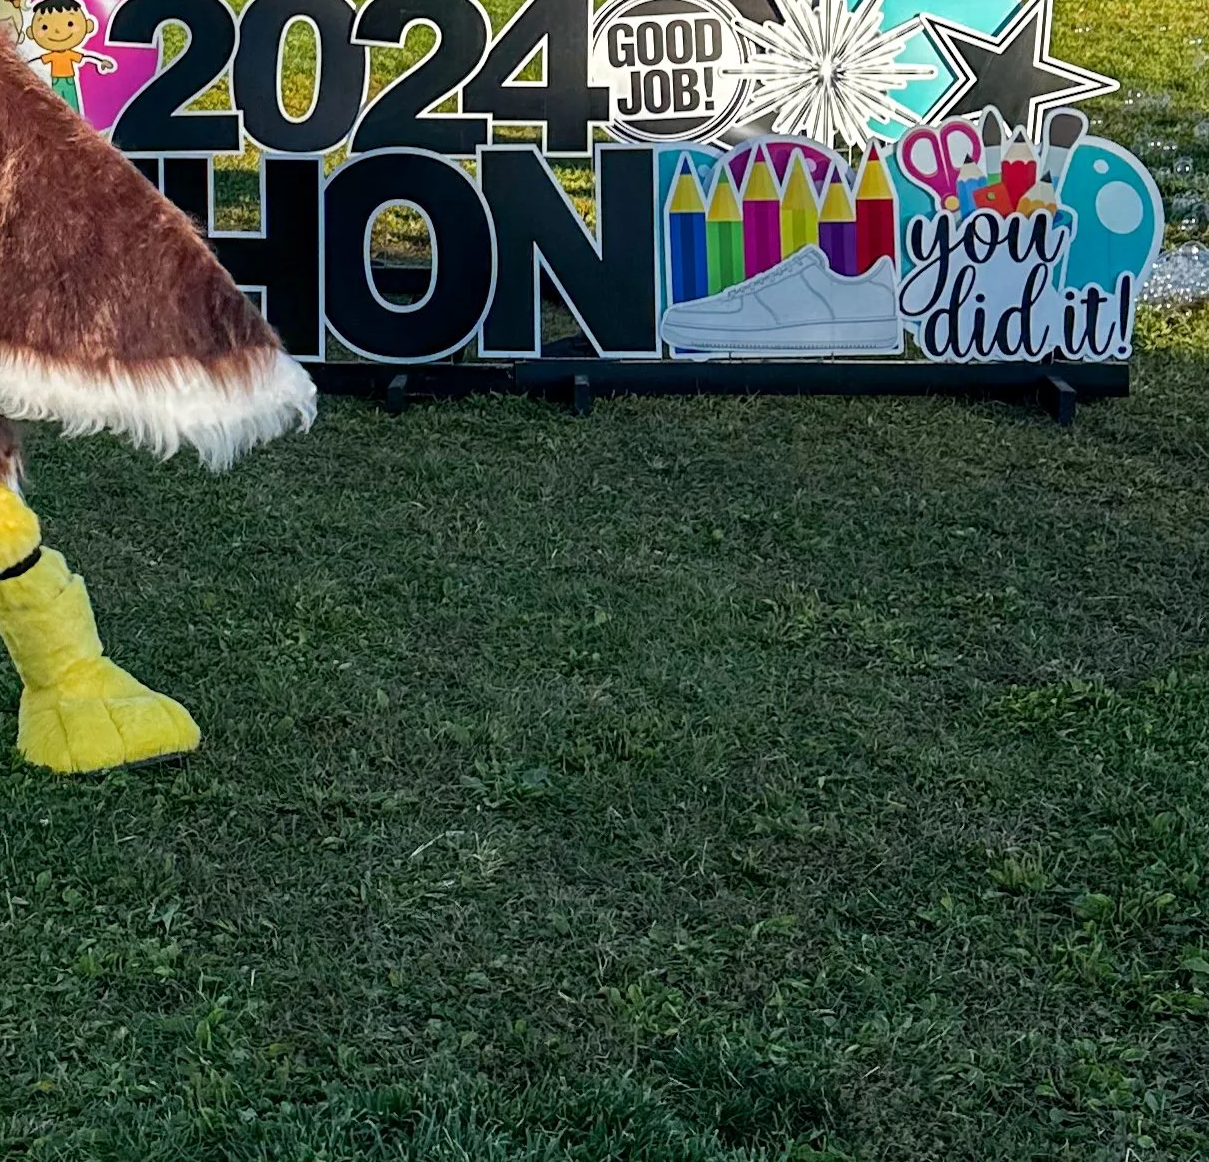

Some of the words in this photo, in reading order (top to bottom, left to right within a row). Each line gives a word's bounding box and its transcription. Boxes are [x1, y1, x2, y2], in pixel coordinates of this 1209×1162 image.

[608, 18, 722, 67] GOOD
[618, 66, 715, 116] JOB!
[899, 213, 1065, 317] you
[924, 262, 1050, 358] did
[1063, 275, 1131, 357] it!
